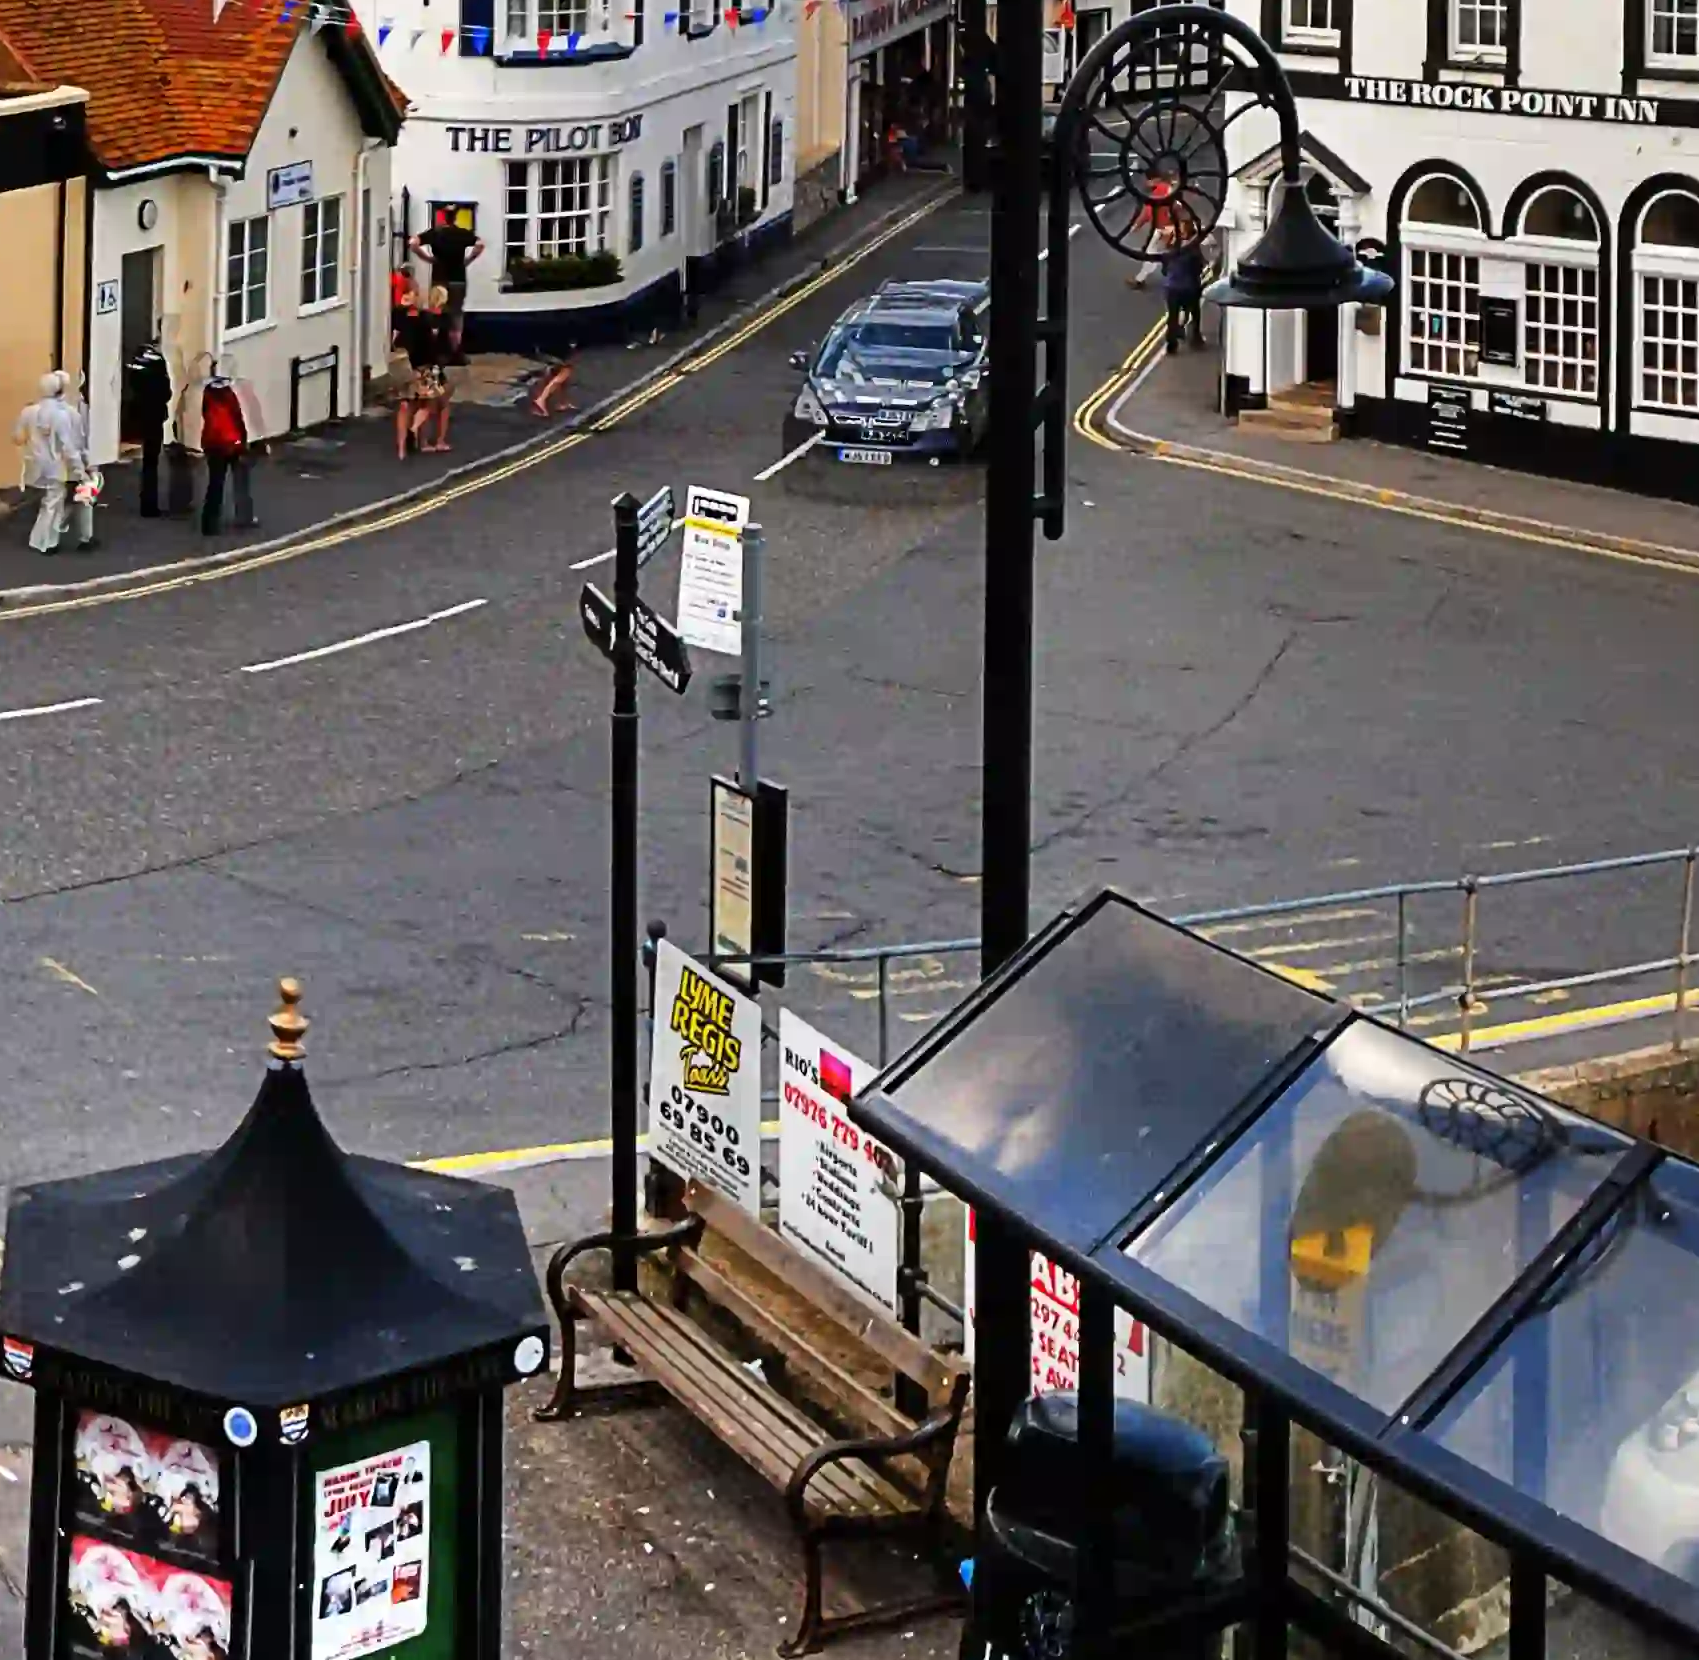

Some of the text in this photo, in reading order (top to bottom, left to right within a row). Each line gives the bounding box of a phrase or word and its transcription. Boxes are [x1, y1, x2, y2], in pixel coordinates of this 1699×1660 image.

[1345, 77, 1659, 123] THE ROCK POINT INN
[446, 127, 512, 152] THE
[525, 124, 601, 153] PILOT
[680, 966, 735, 1031] LYME
[671, 996, 741, 1071] REGIS
[660, 1101, 684, 1130] 69
[723, 1147, 750, 1176] 69
[671, 1085, 739, 1145] 07900
